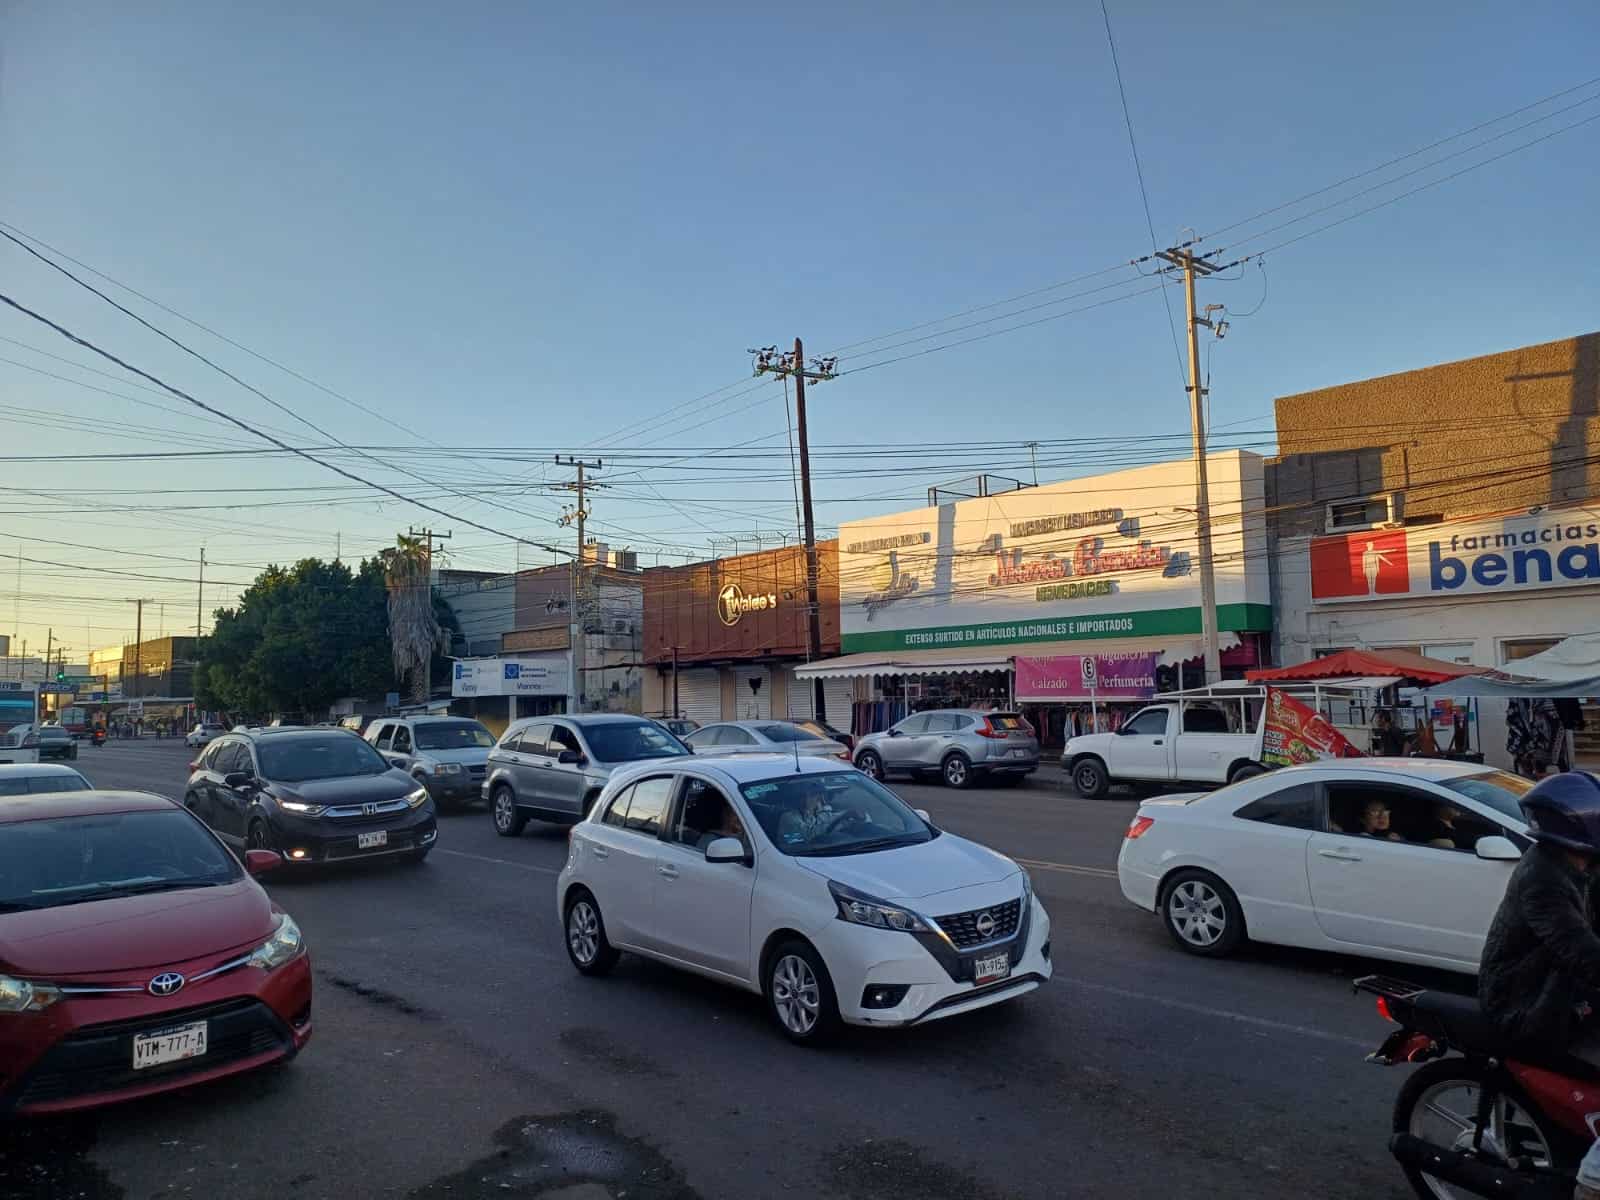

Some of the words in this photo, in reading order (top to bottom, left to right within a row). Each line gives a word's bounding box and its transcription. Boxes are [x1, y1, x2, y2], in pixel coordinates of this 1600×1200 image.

[1450, 524, 1598, 551] farmacias
[1429, 543, 1600, 591] bena
[905, 632, 934, 645] EXTENSO
[935, 630, 964, 643] SURTIDO
[965, 630, 975, 641] EN
[1018, 623, 1067, 637] NACIONALES
[1068, 622, 1075, 634] E
[1076, 618, 1134, 634] IMPORTADOS
[1031, 676, 1069, 689] Calzado
[136, 1031, 205, 1059] VTM-777-A
